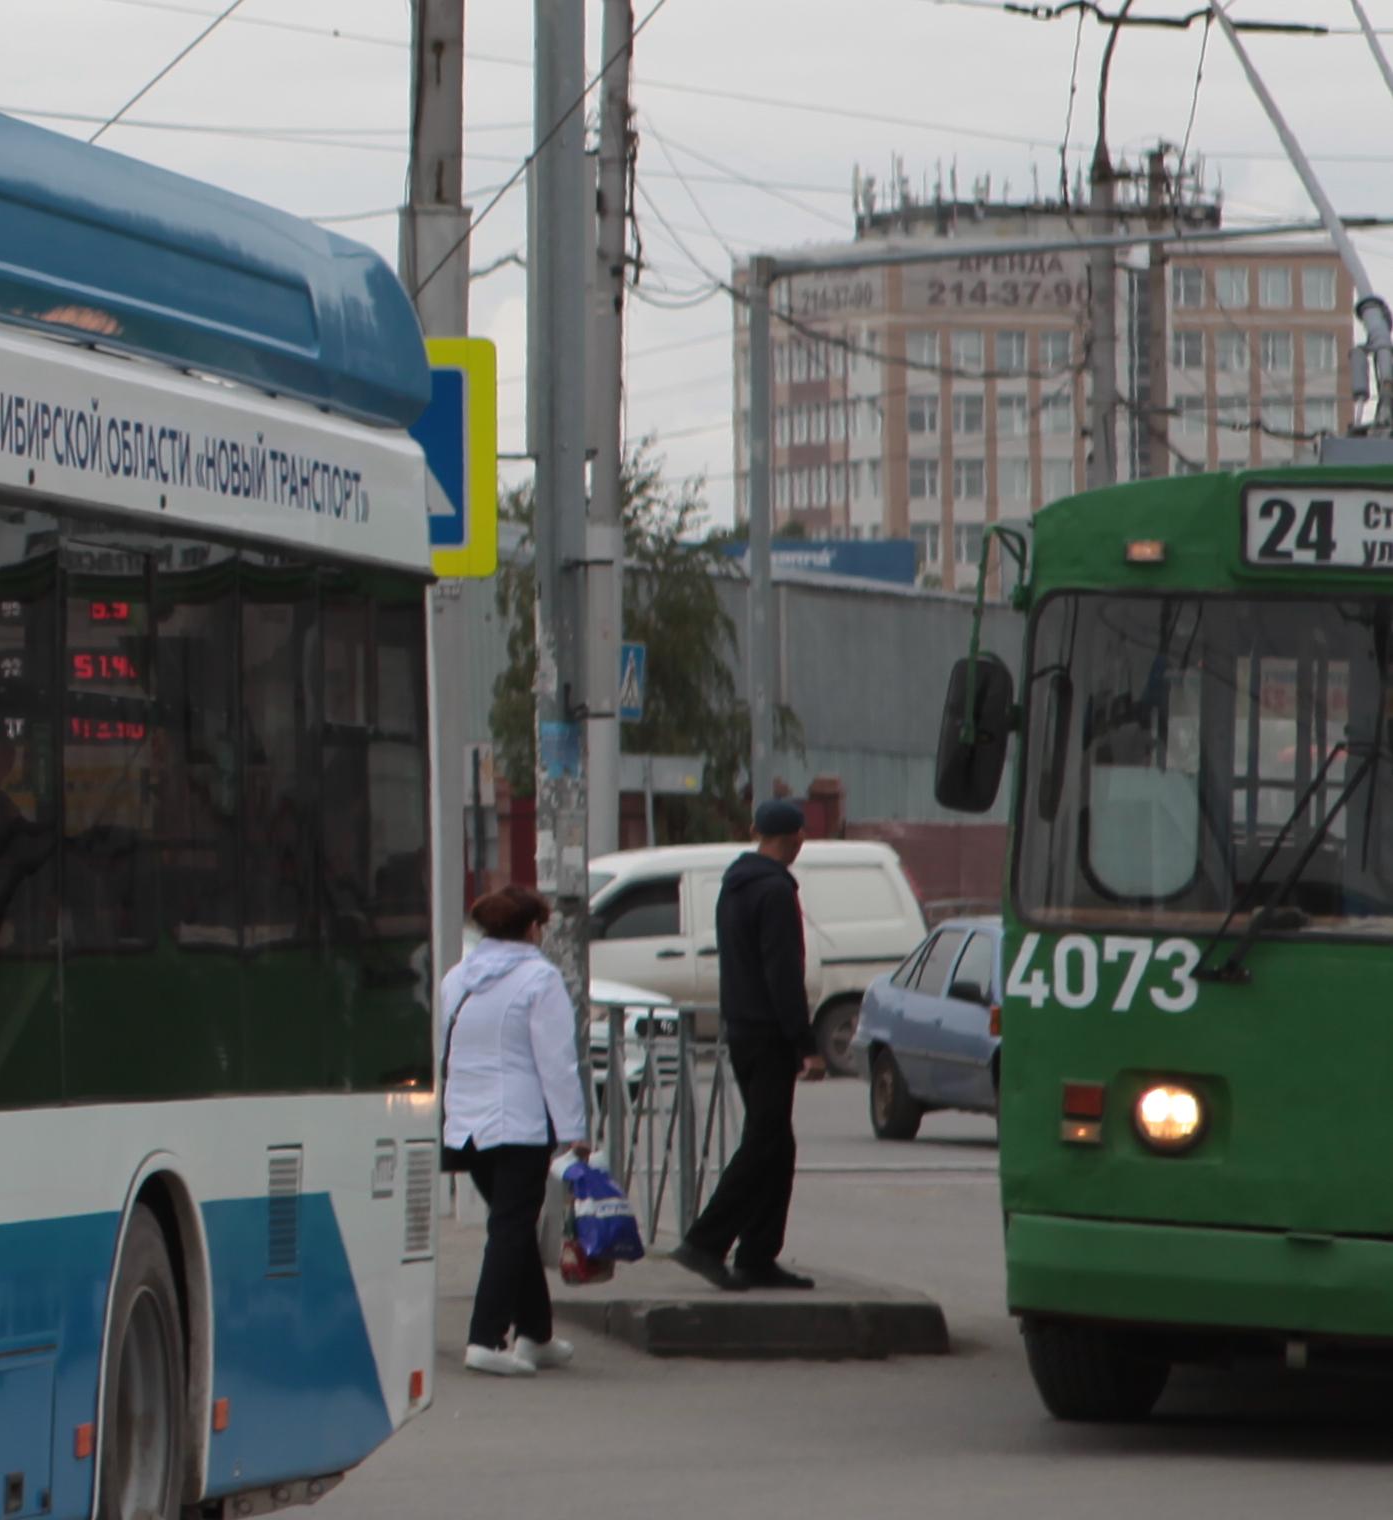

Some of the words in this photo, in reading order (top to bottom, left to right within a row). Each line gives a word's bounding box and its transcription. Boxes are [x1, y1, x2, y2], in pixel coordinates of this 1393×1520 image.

[106, 417, 193, 487] ОБЛАСТИ
[194, 431, 268, 502] «НОВЫЙ
[269, 450, 370, 524] ТРАНСПОРТ»
[1257, 497, 1337, 560] 24
[1006, 932, 1201, 1014] 4073
